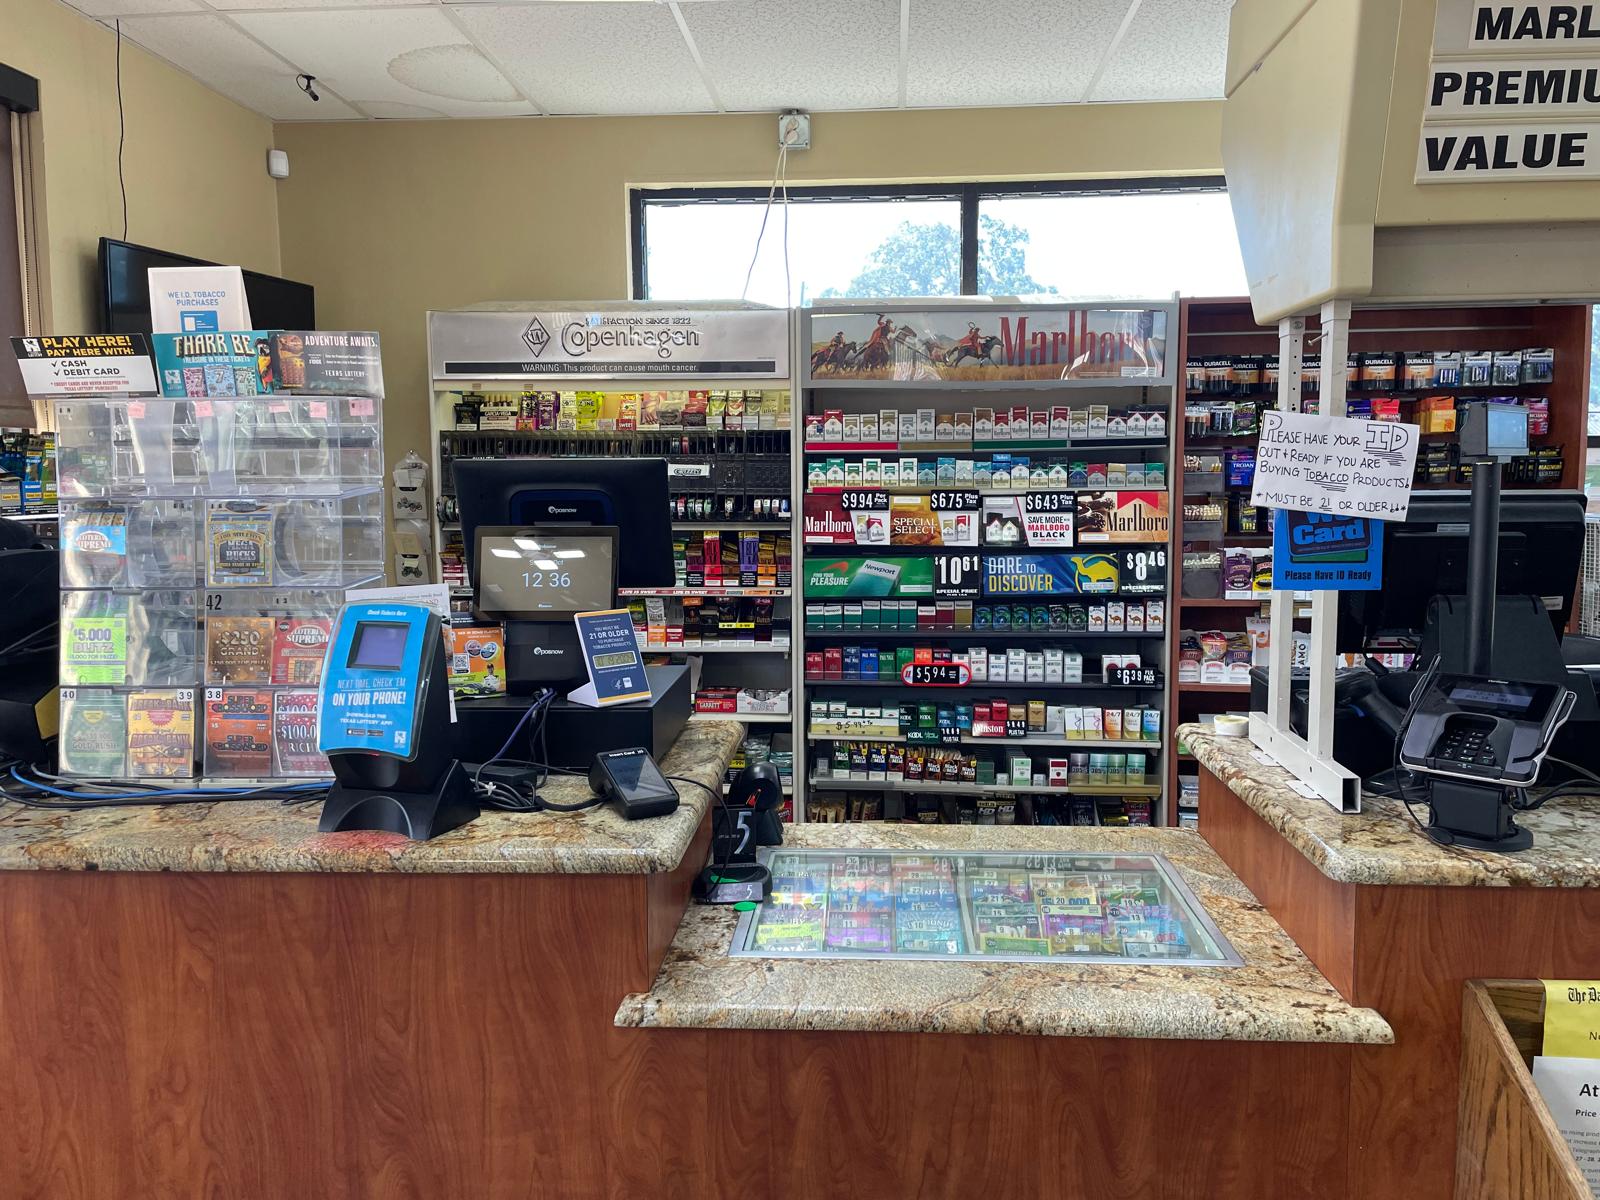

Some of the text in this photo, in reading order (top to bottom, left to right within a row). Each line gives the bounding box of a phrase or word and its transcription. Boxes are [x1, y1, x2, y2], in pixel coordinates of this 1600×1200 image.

[1426, 133, 1588, 171] VALUE
[42, 335, 132, 348] PLAY HERE!
[305, 336, 378, 347] ADVENTURE AWAITS.
[562, 322, 699, 358] Copenhagen
[999, 310, 1149, 366] Marlbor
[73, 348, 105, 356] HERE
[107, 347, 135, 355] WITH:
[173, 334, 256, 357] THARR BE
[522, 363, 560, 372] WARNING:
[563, 364, 578, 372] This
[580, 364, 608, 373] product
[648, 364, 670, 372] mouth
[1260, 413, 1409, 452] PLEASE HAVE YOUR ID
[1259, 447, 1279, 458] OUT
[1290, 449, 1319, 465] READY
[1324, 455, 1333, 465] IF
[1336, 456, 1357, 467] YOU
[1361, 459, 1381, 469] ARE
[1260, 461, 1300, 477] BUYING
[1305, 467, 1349, 482] TOBACCO
[1300, 496, 1313, 506] BE
[1321, 497, 1331, 508] 21
[1339, 500, 1353, 510] OR
[805, 511, 852, 533] Marlboro
[894, 518, 937, 526] SPECIAL
[1106, 503, 1168, 532] Marlboro
[895, 526, 936, 534] SELECT
[1293, 520, 1364, 545] Card
[864, 563, 896, 576] Newport
[988, 557, 1036, 574] DARE TO
[810, 577, 849, 586] PLEASURE
[988, 574, 1053, 592] DISCOVER
[1285, 570, 1372, 582] Please Have ID Ready
[206, 595, 222, 610] 42
[221, 631, 260, 645] $250
[609, 629, 630, 638] OLDER
[338, 679, 353, 688] NEXT
[373, 678, 392, 687] CHECK
[62, 691, 75, 699] 40
[179, 691, 193, 700] 39
[207, 691, 221, 699] 38
[333, 691, 406, 706] ON YOUR PHONE!
[998, 805, 1014, 813] HD
[734, 812, 752, 854] 5
[746, 885, 752, 899] 5
[1575, 1109, 1597, 1118] Price
